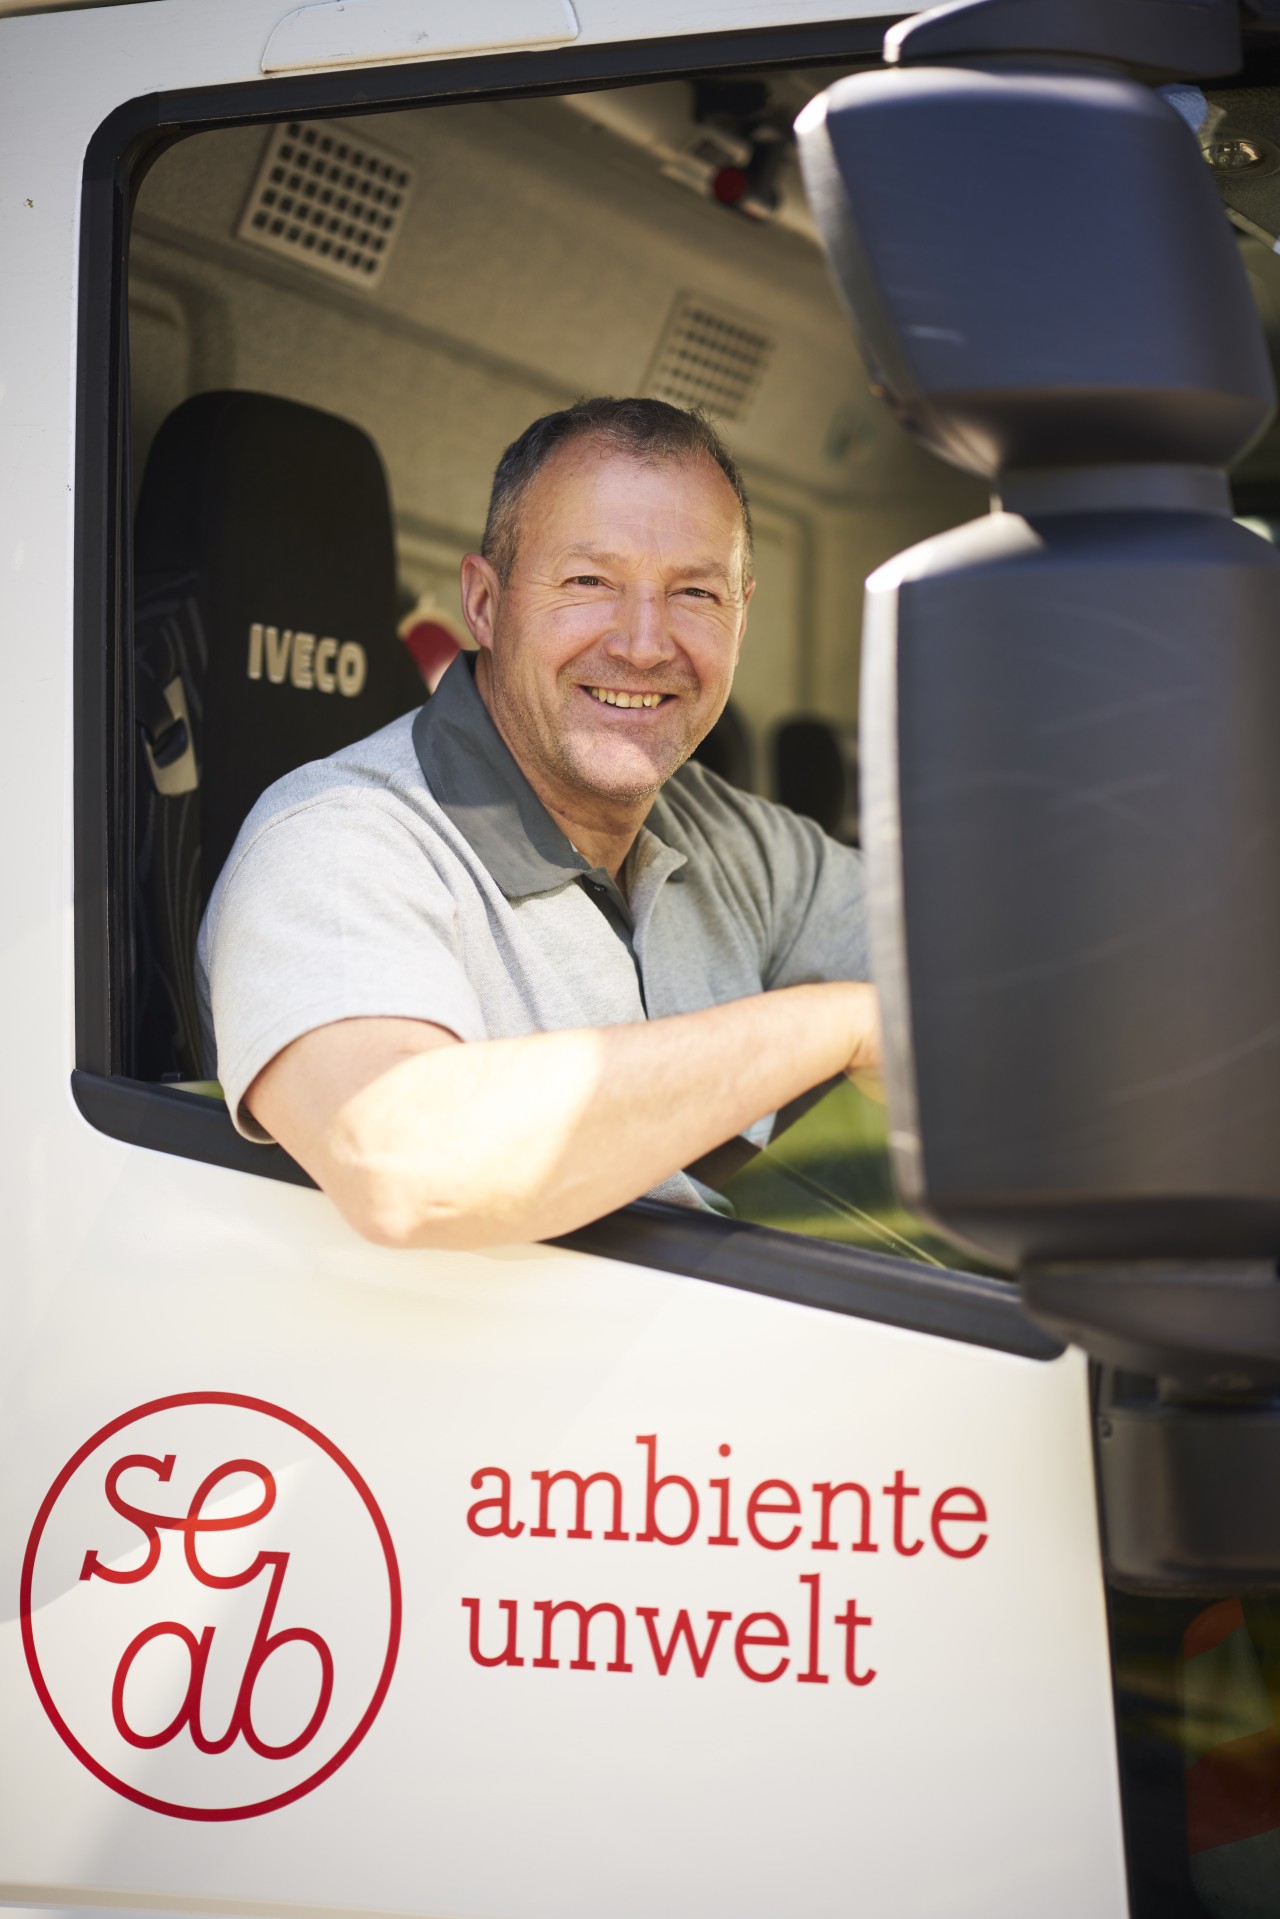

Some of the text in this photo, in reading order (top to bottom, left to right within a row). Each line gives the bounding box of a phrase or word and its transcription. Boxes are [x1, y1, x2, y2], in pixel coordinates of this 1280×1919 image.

[248, 622, 367, 697] IVECO
[466, 1433, 988, 1559] ambiente
[461, 1573, 877, 1687] umwelt
